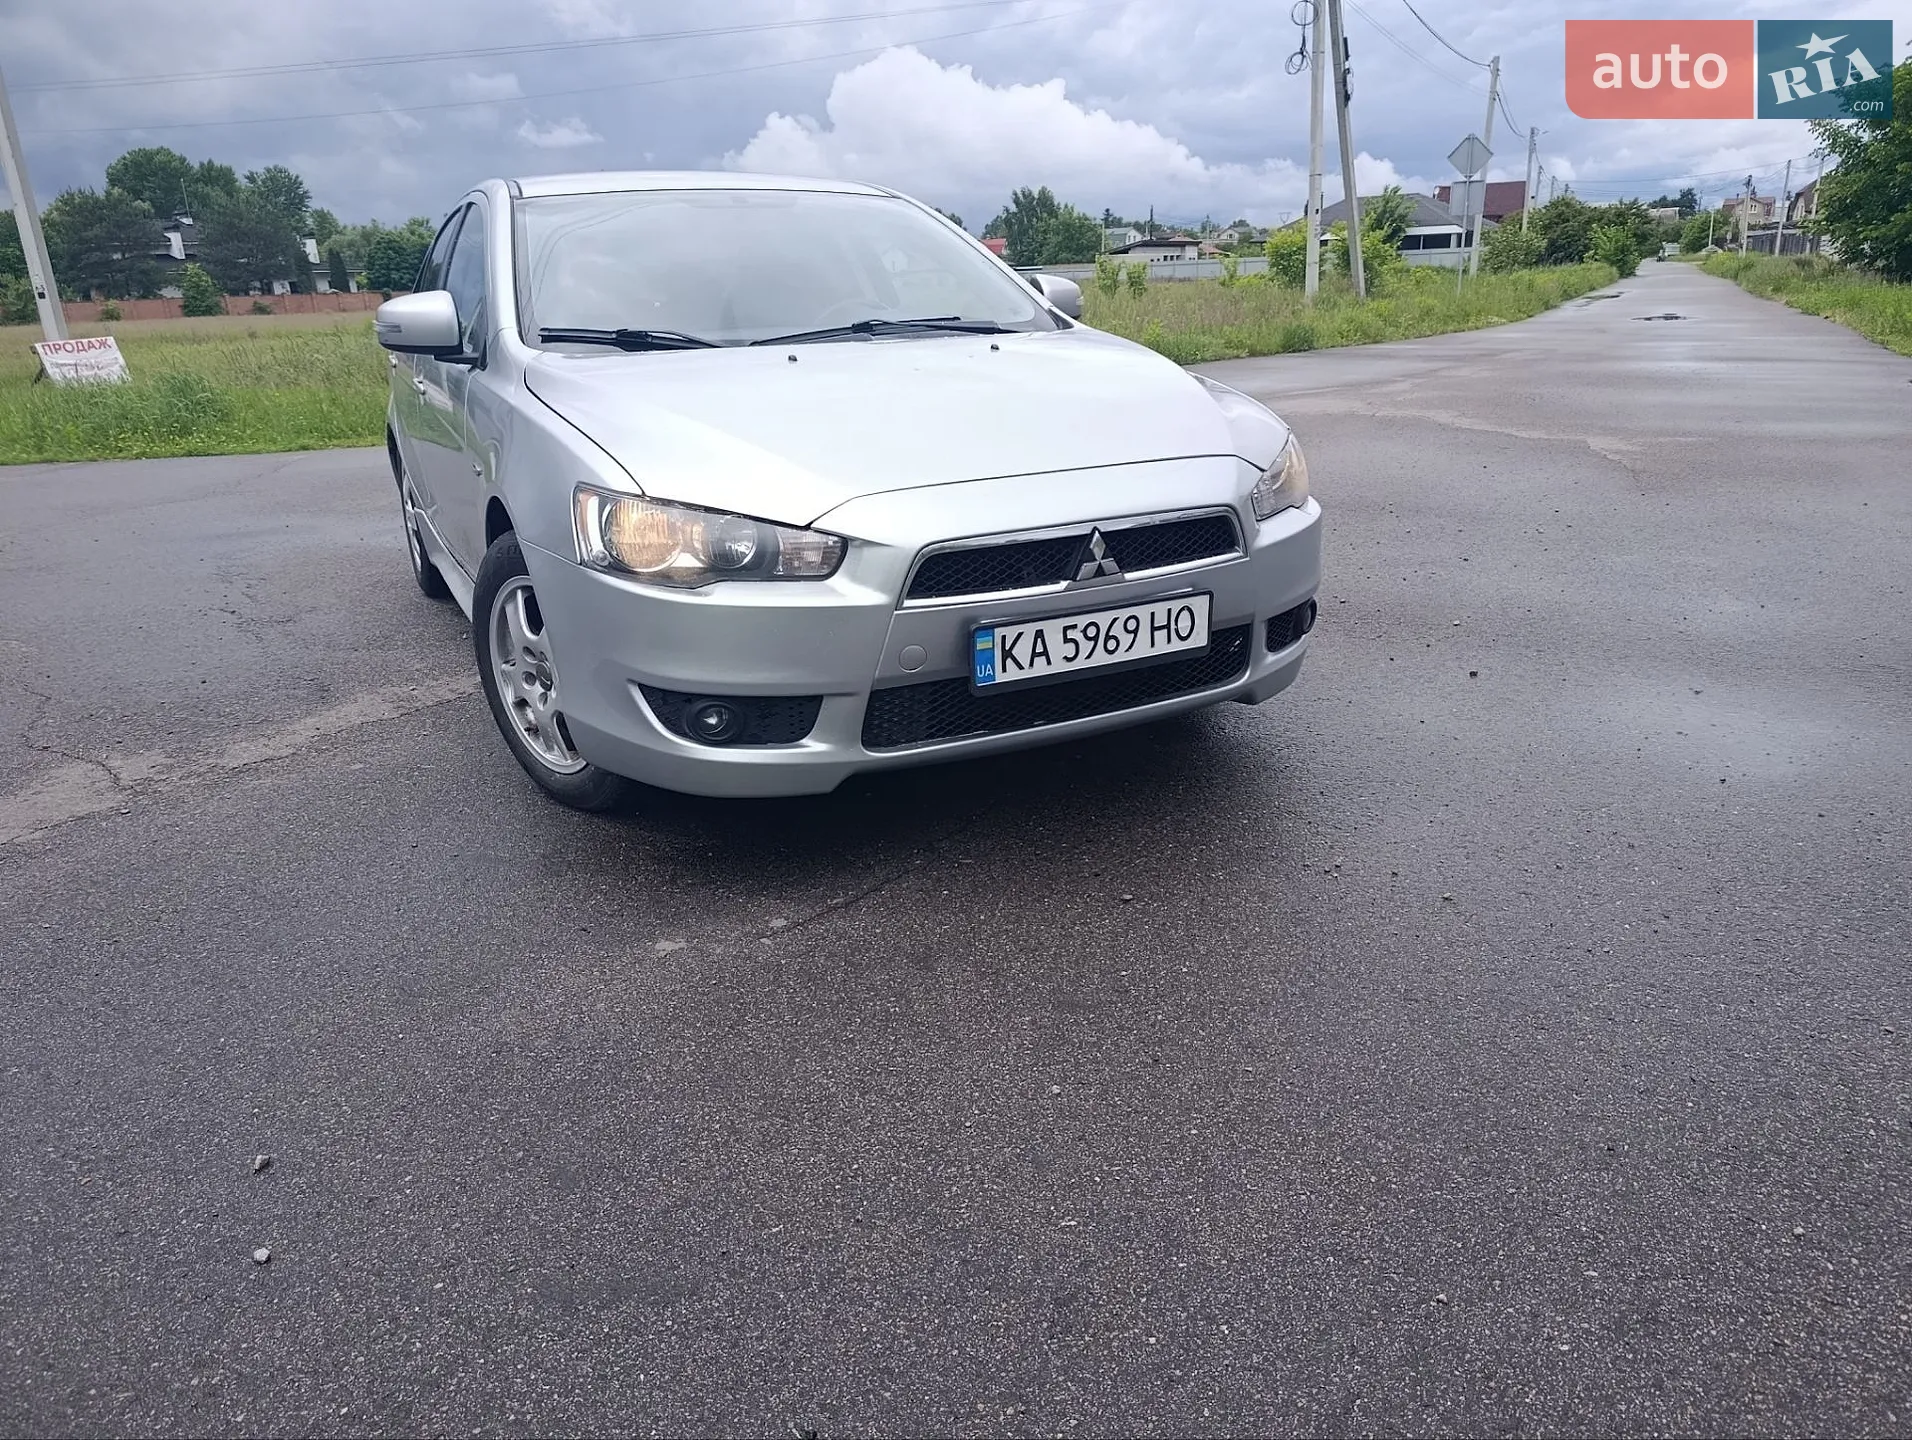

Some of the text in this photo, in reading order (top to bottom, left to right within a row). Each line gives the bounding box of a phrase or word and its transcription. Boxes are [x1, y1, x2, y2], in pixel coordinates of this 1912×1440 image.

[41, 338, 112, 355] ПРОДАЖ
[1000, 605, 1196, 673] KA 5969 HO
[976, 664, 993, 678] UA
